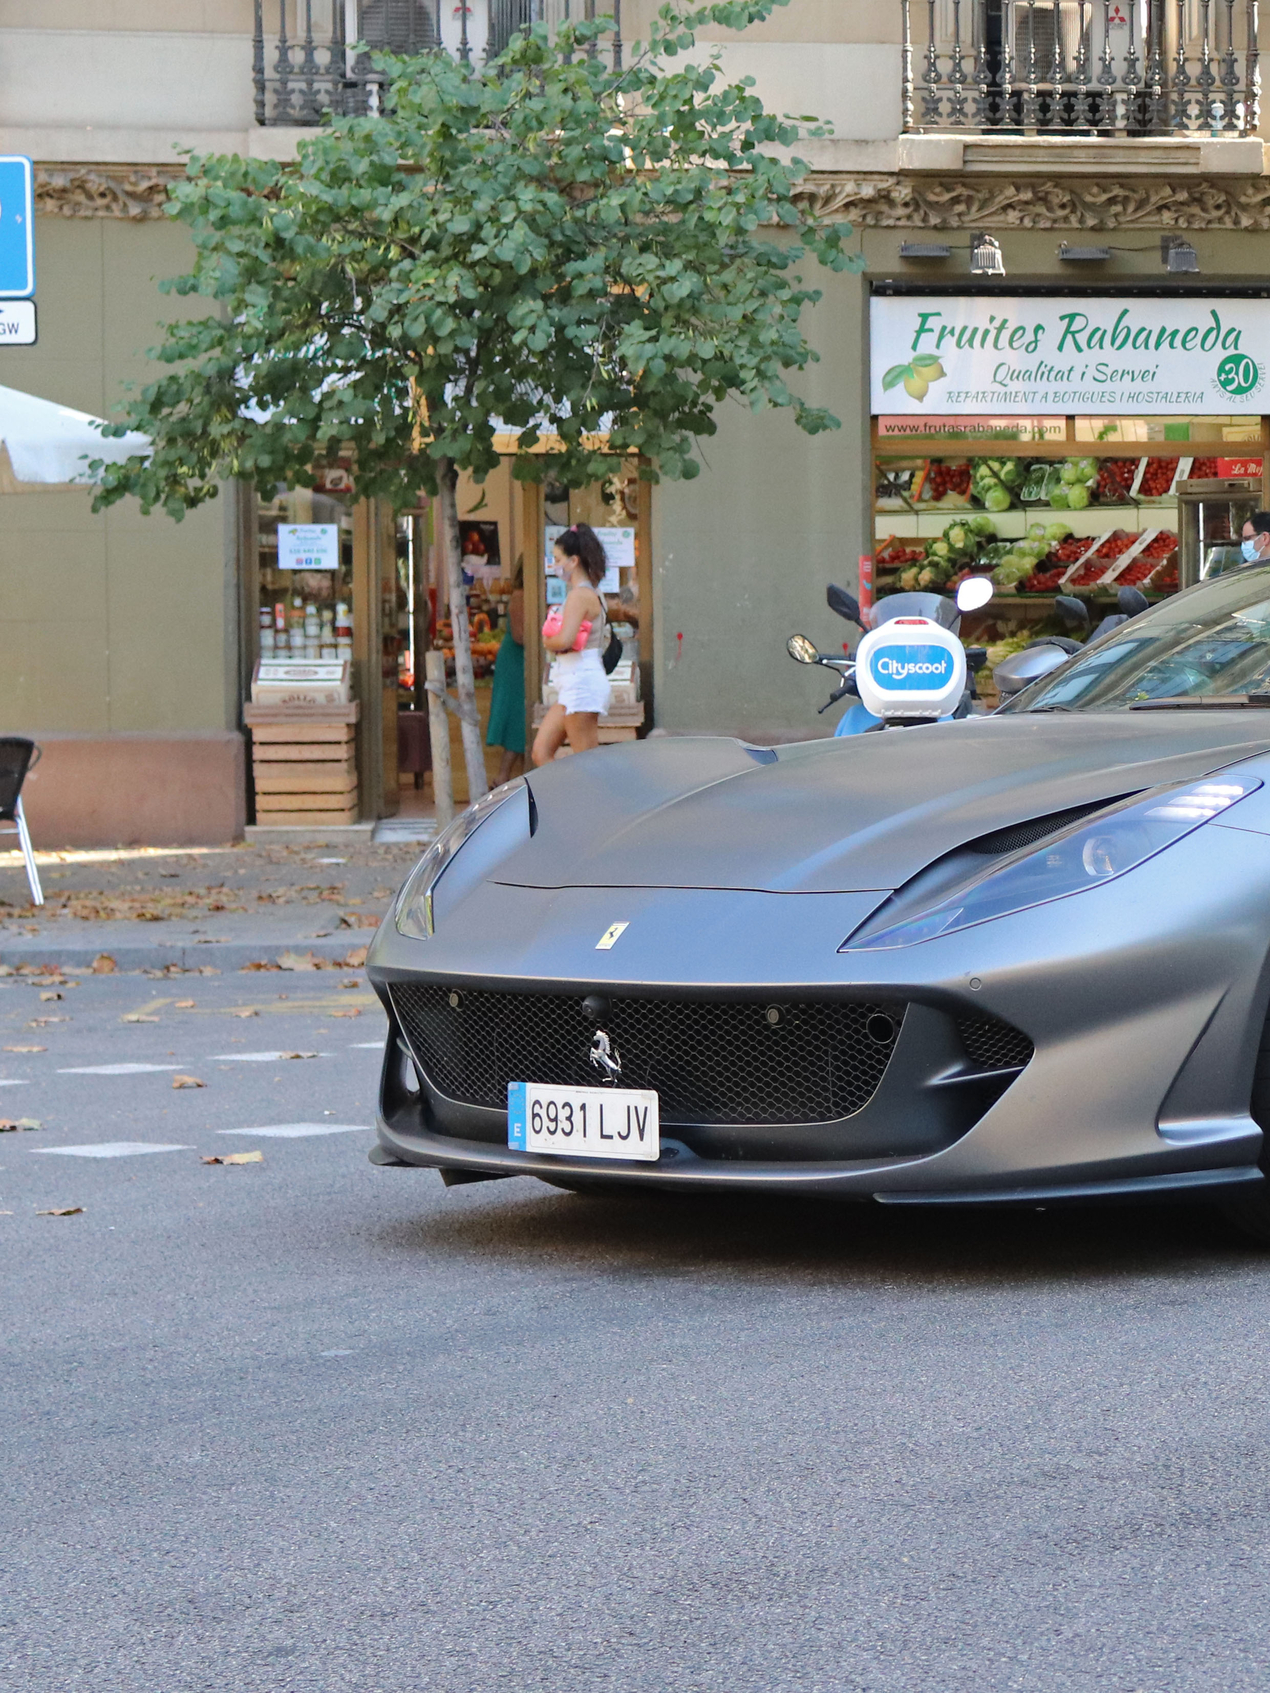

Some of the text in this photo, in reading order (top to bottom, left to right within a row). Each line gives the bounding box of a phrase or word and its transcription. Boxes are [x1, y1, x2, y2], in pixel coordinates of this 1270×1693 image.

[911, 308, 1242, 353] Fruites Rabaneda
[991, 361, 1159, 387] Qualitat i Servei
[1219, 358, 1253, 391] +30
[946, 390, 1205, 404] REPARTIMENT A BOTIGUES I HOSTALERIA
[1231, 463, 1245, 474] La
[877, 657, 947, 679] Cityscoot
[513, 1123, 522, 1137] E
[531, 1100, 648, 1141] 6931 LJV
